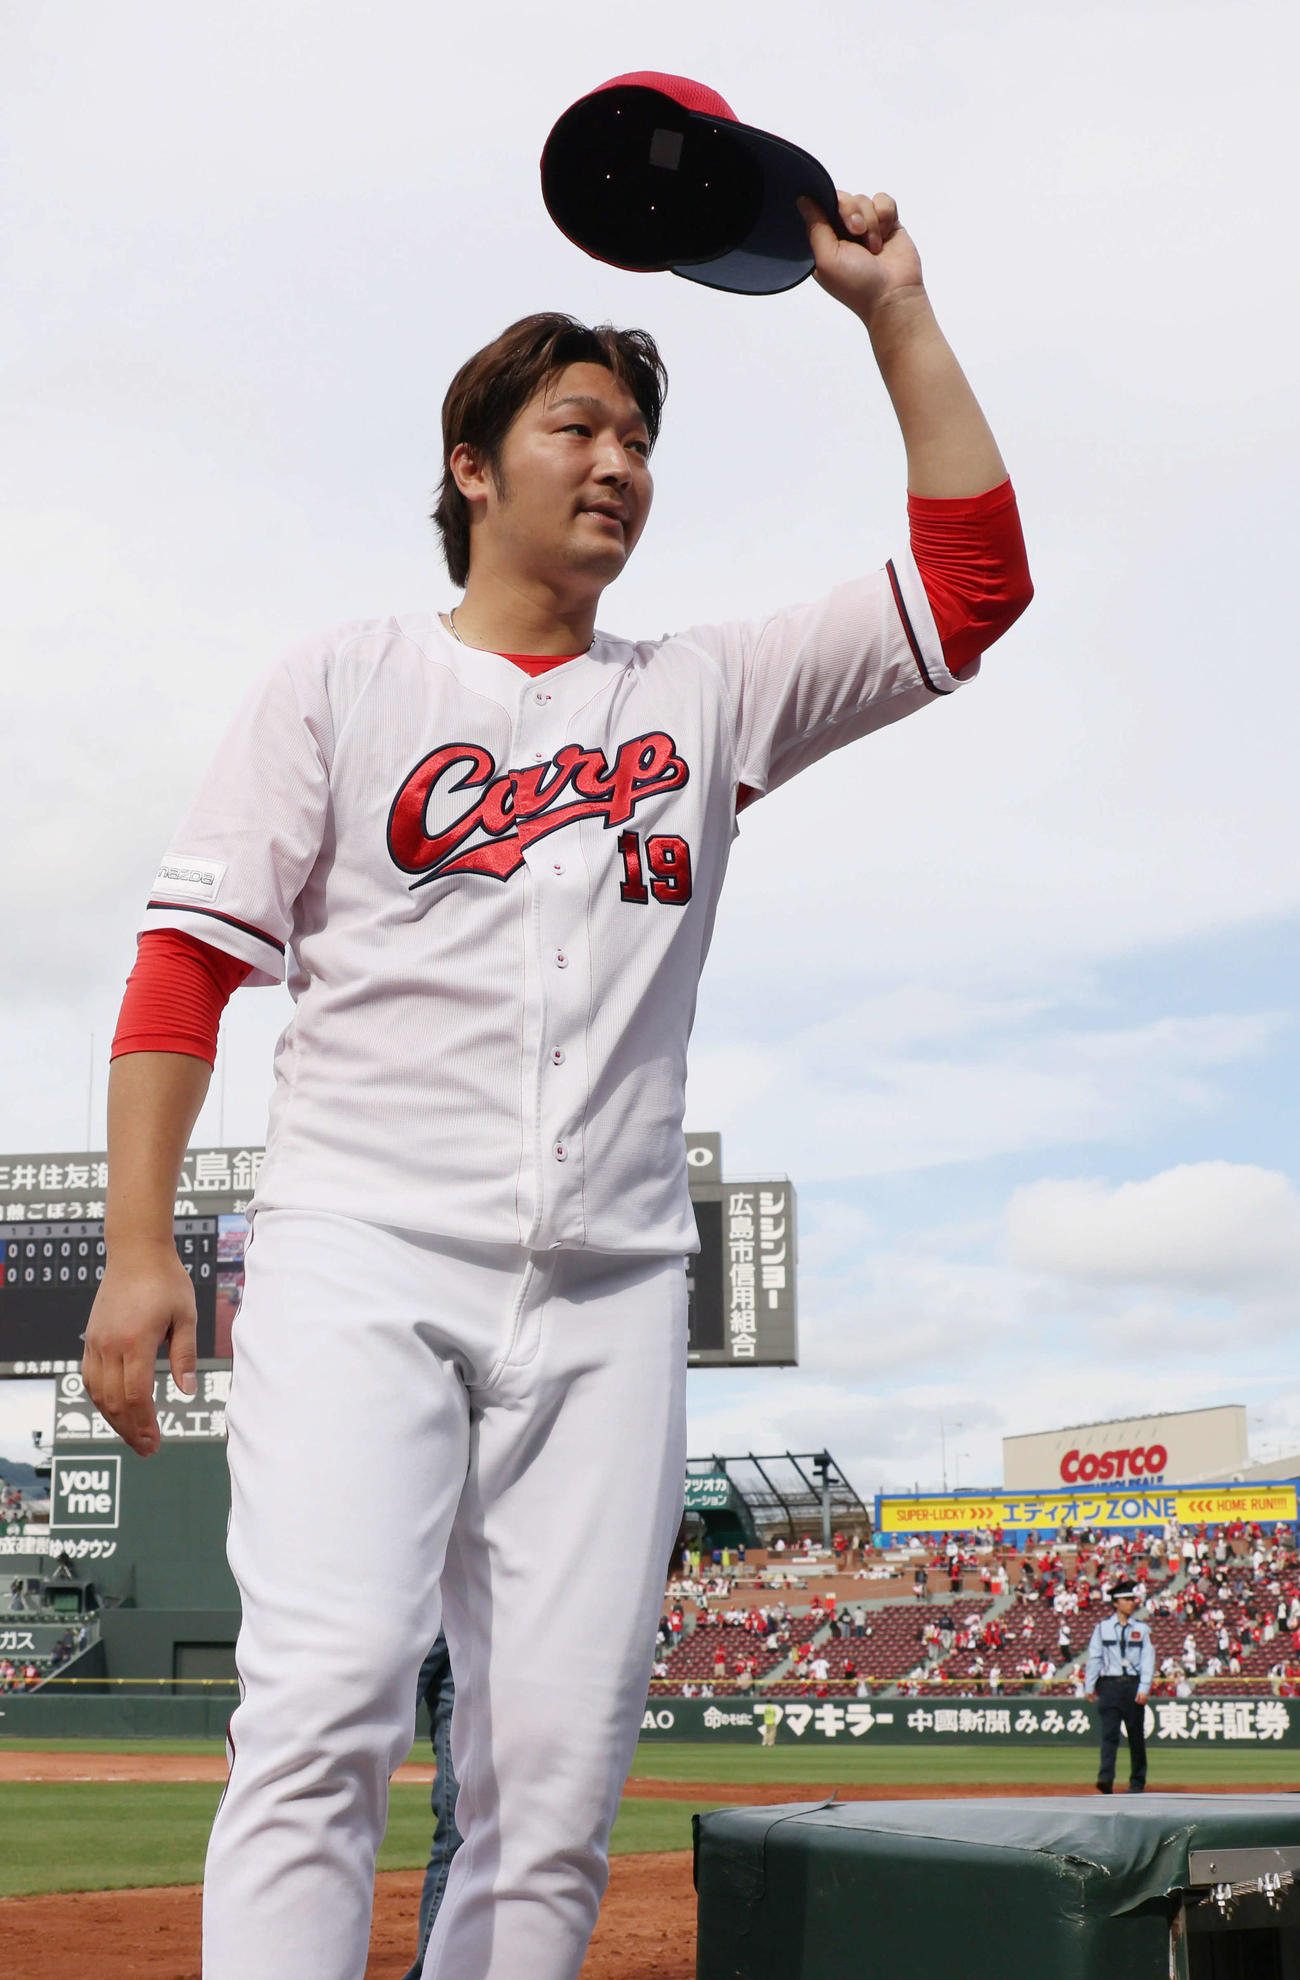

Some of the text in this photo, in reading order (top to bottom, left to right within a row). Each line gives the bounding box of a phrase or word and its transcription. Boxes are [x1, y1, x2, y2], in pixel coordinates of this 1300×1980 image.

[387, 731, 690, 890] Carp
[618, 830, 692, 906] 19
[8, 1243, 18, 1258] 0
[26, 1243, 36, 1257] 0
[43, 1242, 53, 1257] 0
[61, 1242, 71, 1257] 0
[79, 1242, 88, 1256] 0
[184, 1239, 194, 1254] 5
[202, 1239, 209, 1253] 1
[7, 1268, 17, 1282] 0
[25, 1268, 35, 1282] 0
[43, 1267, 53, 1281] 3
[60, 1266, 70, 1281] 0
[78, 1266, 88, 1281] 0
[200, 1263, 211, 1278] 0
[728, 1192, 757, 1358] 広島市信用組合
[1060, 1445, 1168, 1483] COSTCO
[59, 1470, 110, 1496] you
[67, 1493, 112, 1514] me
[896, 1507, 967, 1522] SUPER-LUCKY
[1216, 1499, 1248, 1512] HOME
[49, 1539, 117, 1559] ゆめタウン
[1155, 1701, 1290, 1740] 東洋証券
